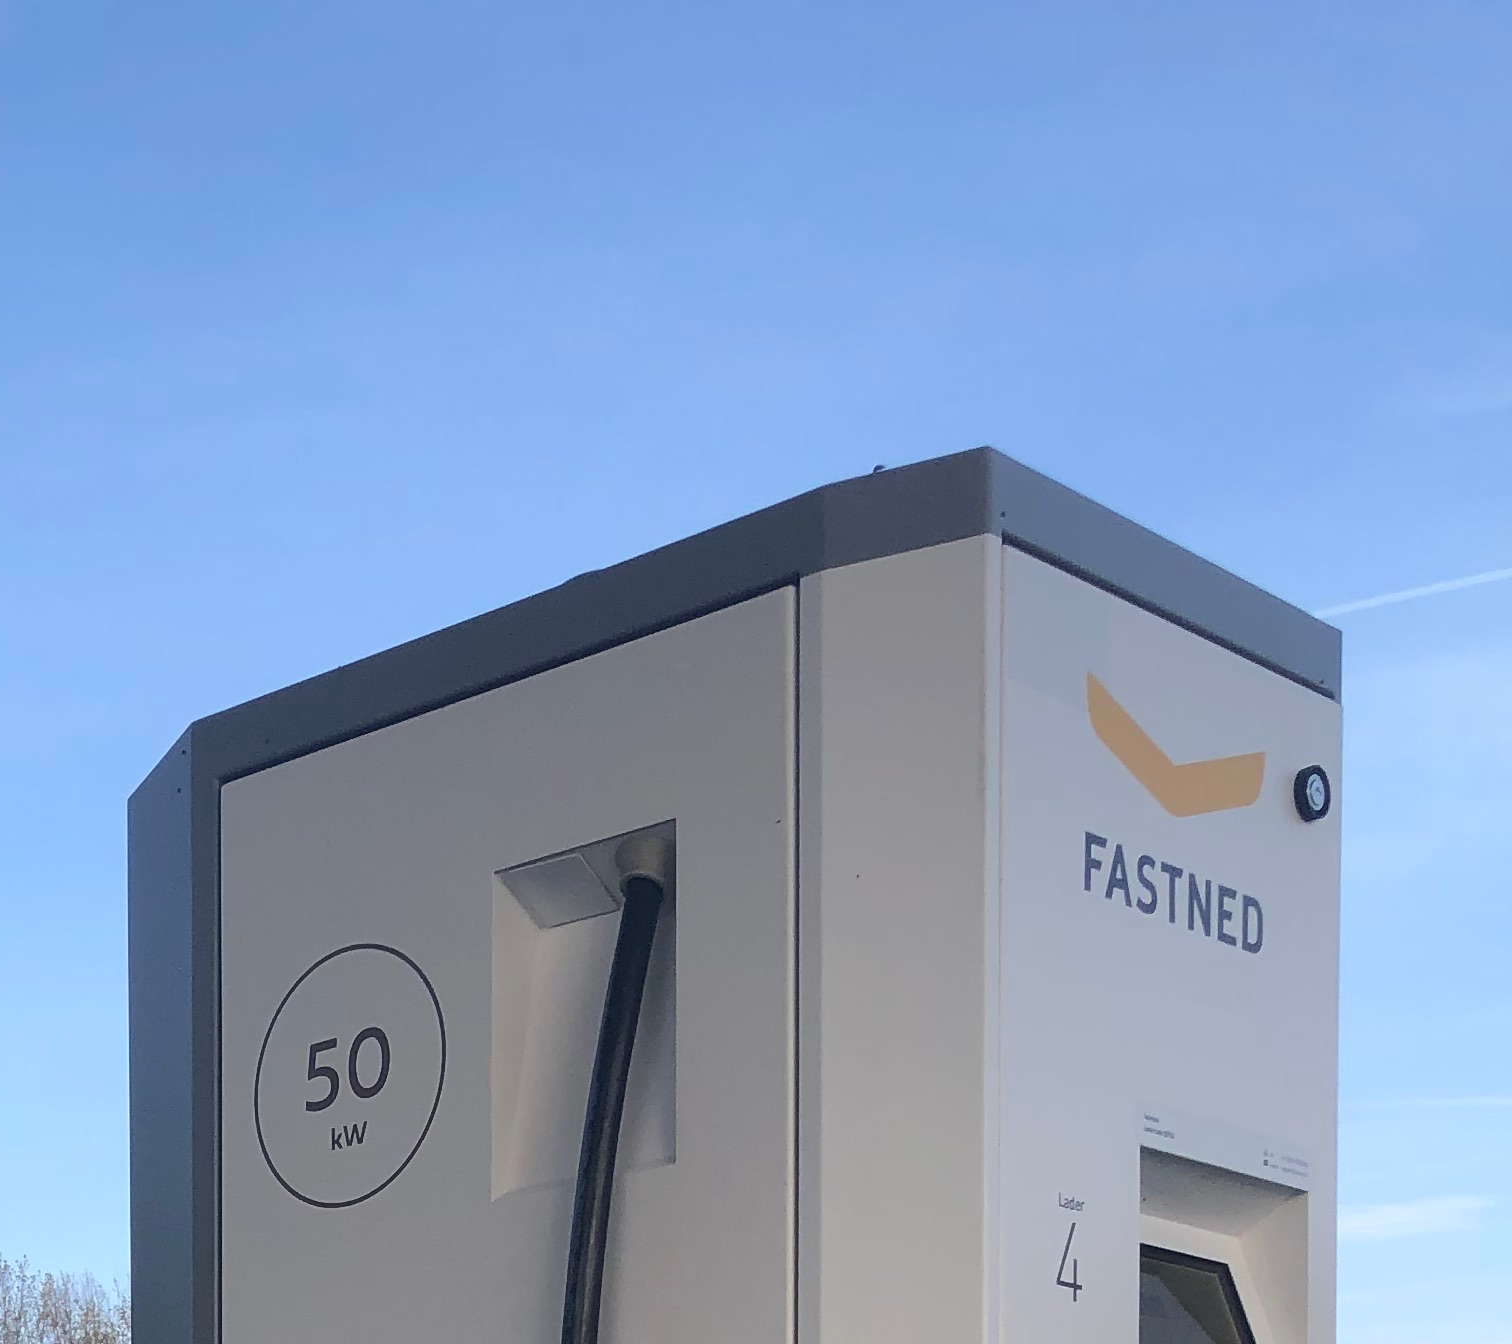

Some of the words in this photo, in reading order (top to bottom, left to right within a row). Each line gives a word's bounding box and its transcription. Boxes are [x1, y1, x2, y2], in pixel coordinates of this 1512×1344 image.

[1083, 831, 1265, 954] FASTNED
[305, 1026, 391, 1112] 50
[331, 1120, 368, 1150] kW
[1058, 1192, 1085, 1212] Lader
[1056, 1222, 1083, 1302] 4
